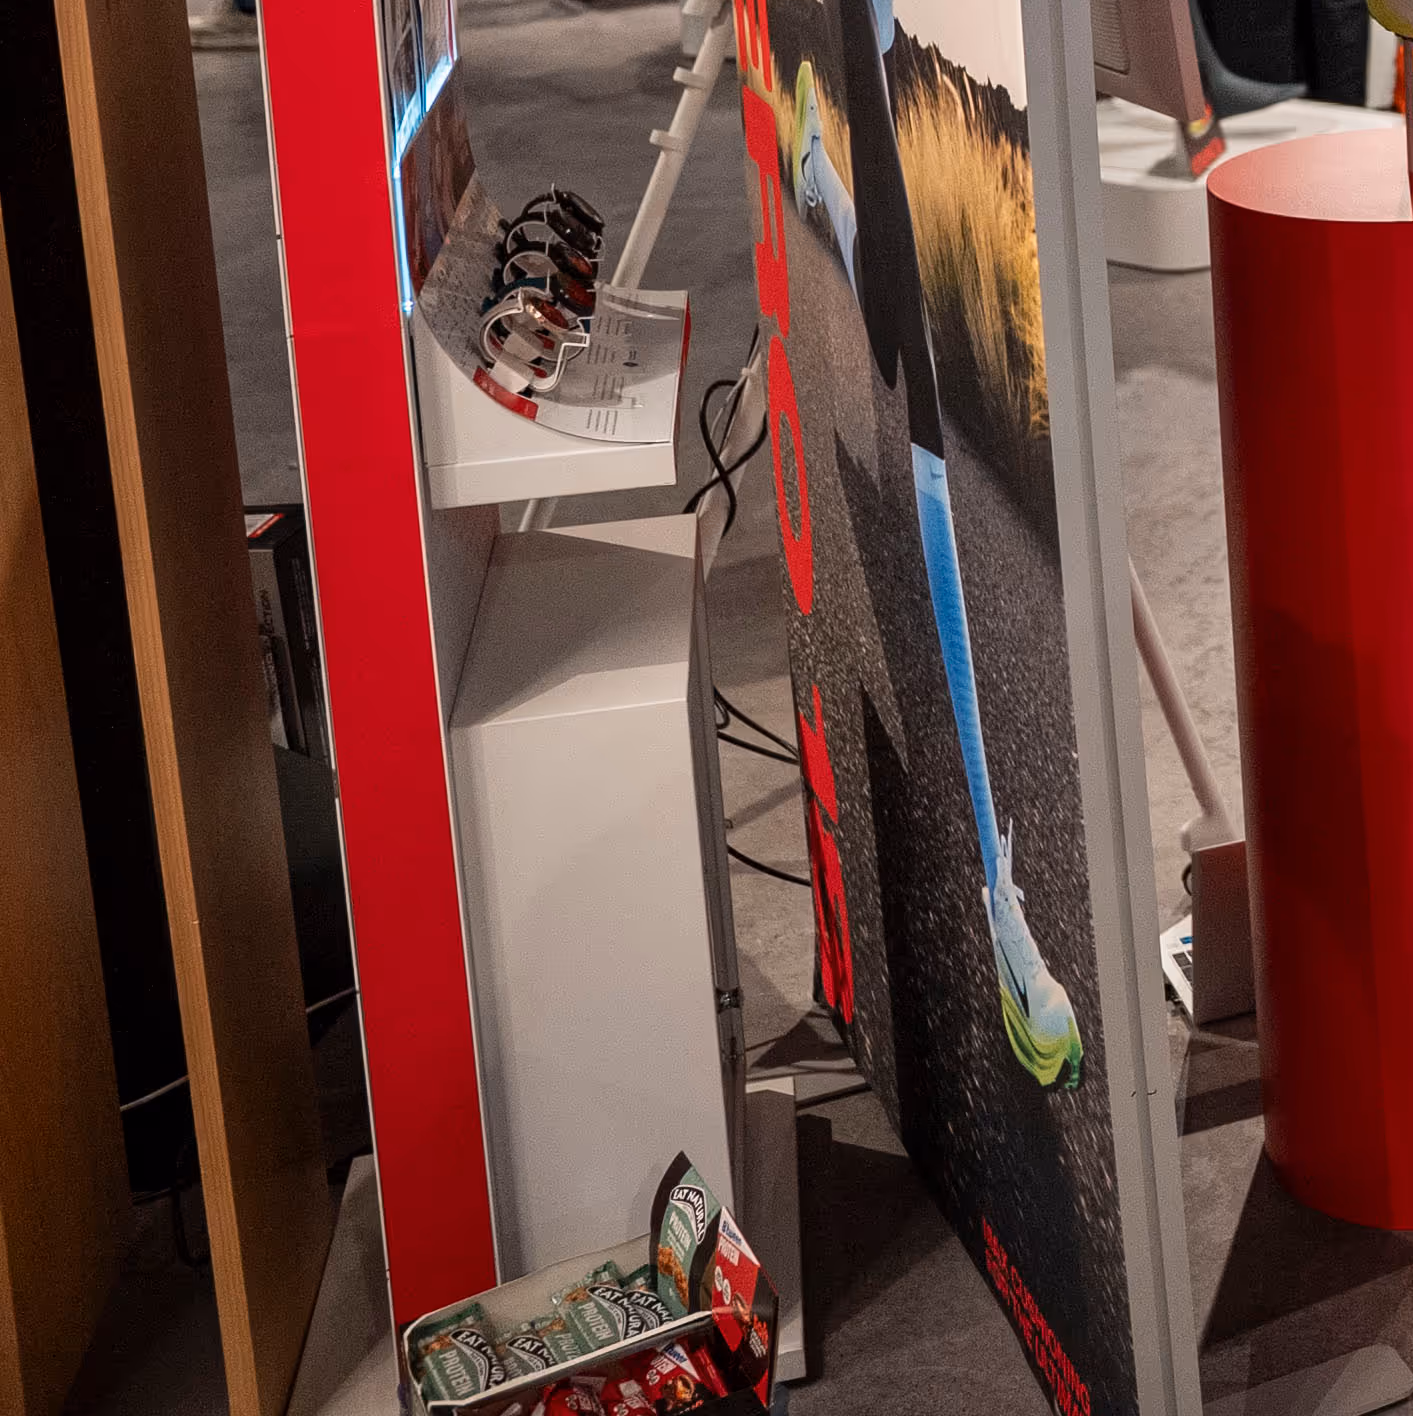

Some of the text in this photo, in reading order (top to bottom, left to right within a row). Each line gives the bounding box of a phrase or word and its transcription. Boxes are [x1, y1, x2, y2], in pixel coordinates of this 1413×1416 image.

[672, 1187, 706, 1240] EAT NATURAL
[594, 1287, 642, 1339] EAT NATURA
[456, 1330, 487, 1348] EAT
[512, 1338, 543, 1353] EAT
